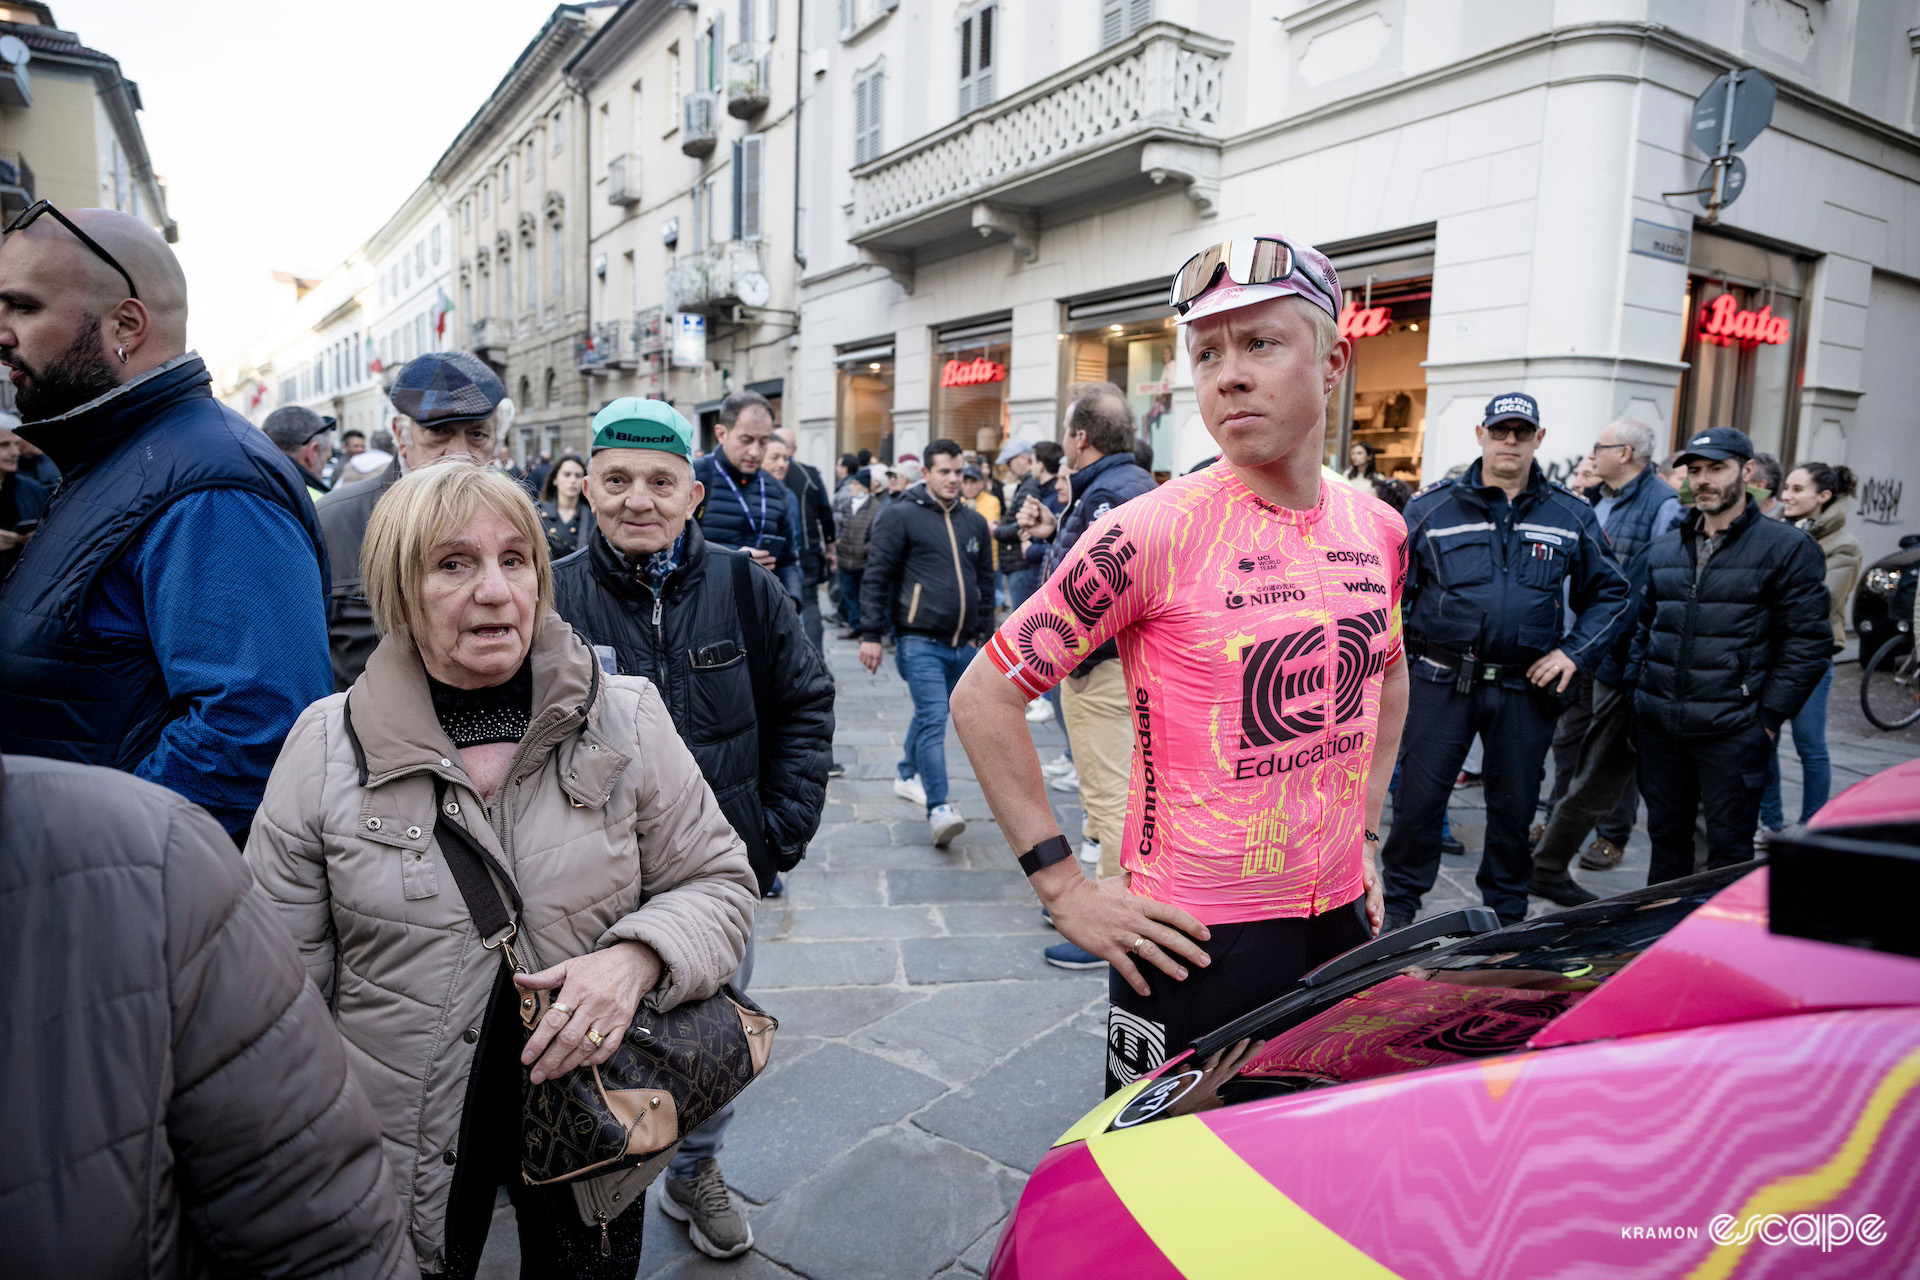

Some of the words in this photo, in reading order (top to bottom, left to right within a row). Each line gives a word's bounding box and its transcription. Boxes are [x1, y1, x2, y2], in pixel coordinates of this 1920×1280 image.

[1338, 302, 1390, 338] ta
[1706, 294, 1790, 345] Bata
[939, 357, 995, 388] Bata
[1494, 395, 1533, 411] POLIZIA
[1494, 404, 1533, 417] LOCALE
[616, 431, 675, 444] Bianchi
[1253, 497, 1278, 515] Rapha
[1327, 551, 1381, 566] easypost
[1343, 578, 1386, 595] wahoo
[1250, 589, 1306, 606] NIPPO
[1235, 731, 1364, 781] Education
[1136, 687, 1157, 856] cannondale
